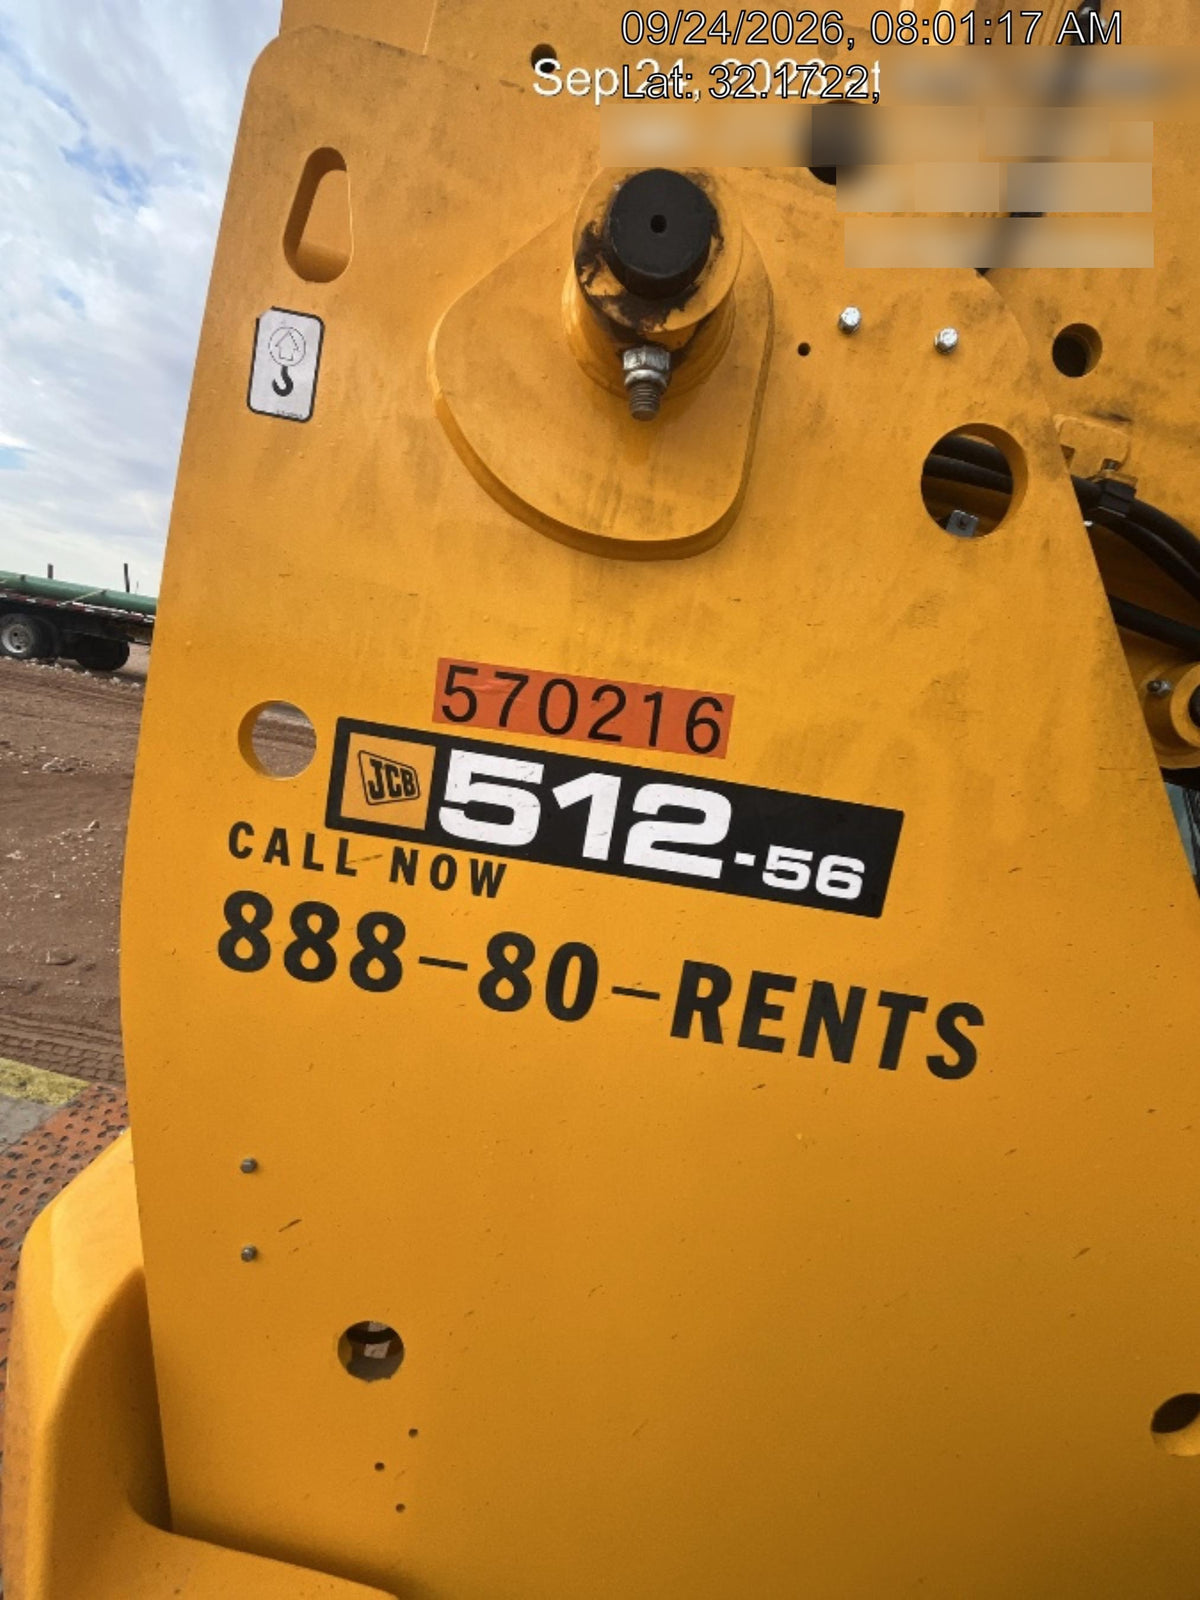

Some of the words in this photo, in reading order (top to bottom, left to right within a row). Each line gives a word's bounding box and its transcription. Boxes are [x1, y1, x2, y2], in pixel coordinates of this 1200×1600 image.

[441, 664, 725, 755] 570216
[366, 758, 420, 799] JCB
[228, 821, 358, 877] CALL
[389, 846, 507, 899] NOW
[218, 890, 985, 1080] 888-80-RENTS
